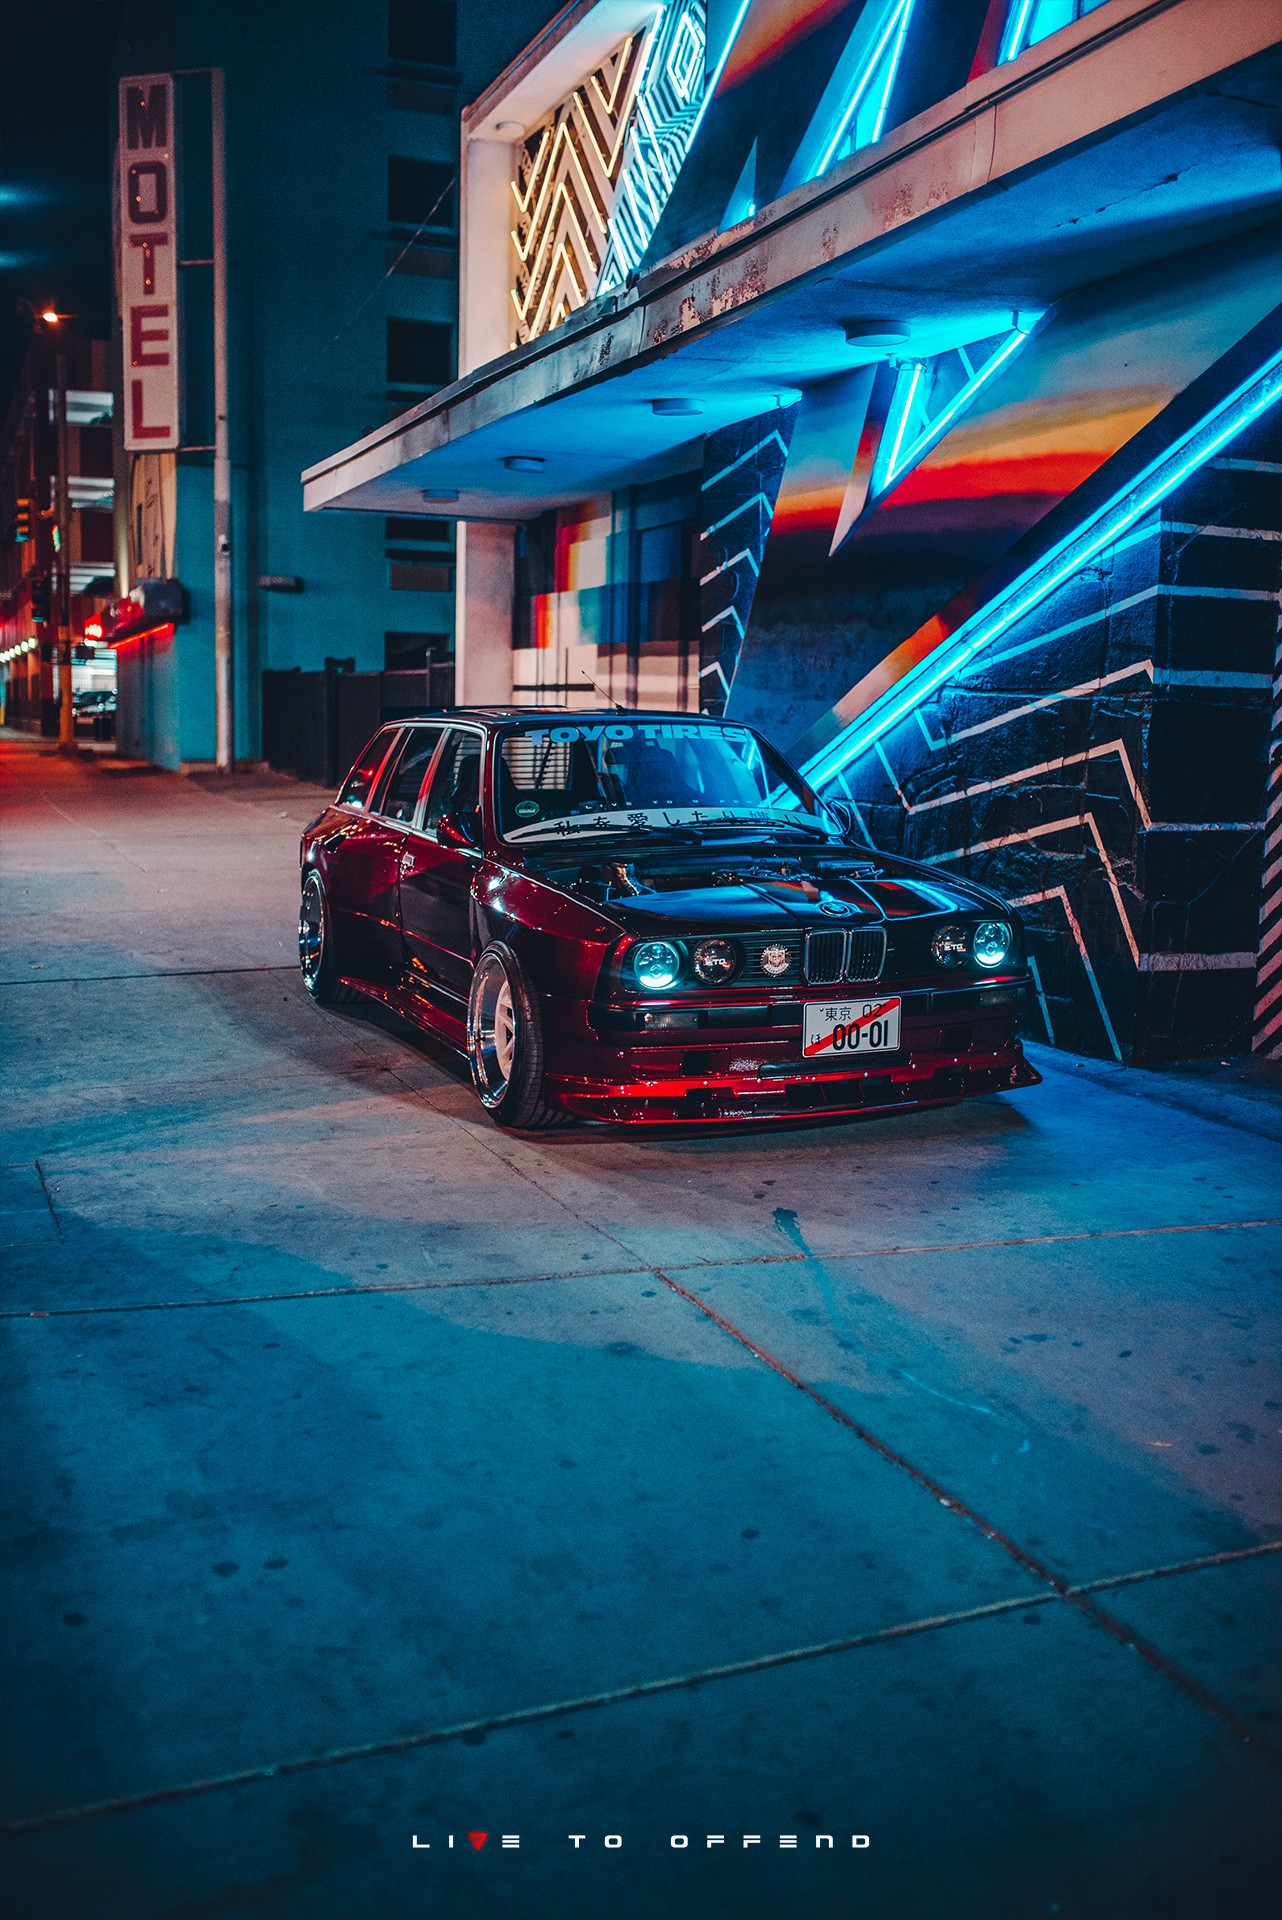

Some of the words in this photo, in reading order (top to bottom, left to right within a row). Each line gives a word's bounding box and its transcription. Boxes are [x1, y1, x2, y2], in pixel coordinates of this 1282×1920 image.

[126, 85, 171, 440] MOTEL
[525, 724, 634, 746] TOYO
[637, 724, 747, 743] TIRES
[825, 1007, 852, 1021] 東京
[863, 1004, 882, 1018] 02
[833, 1020, 888, 1050] 00-01
